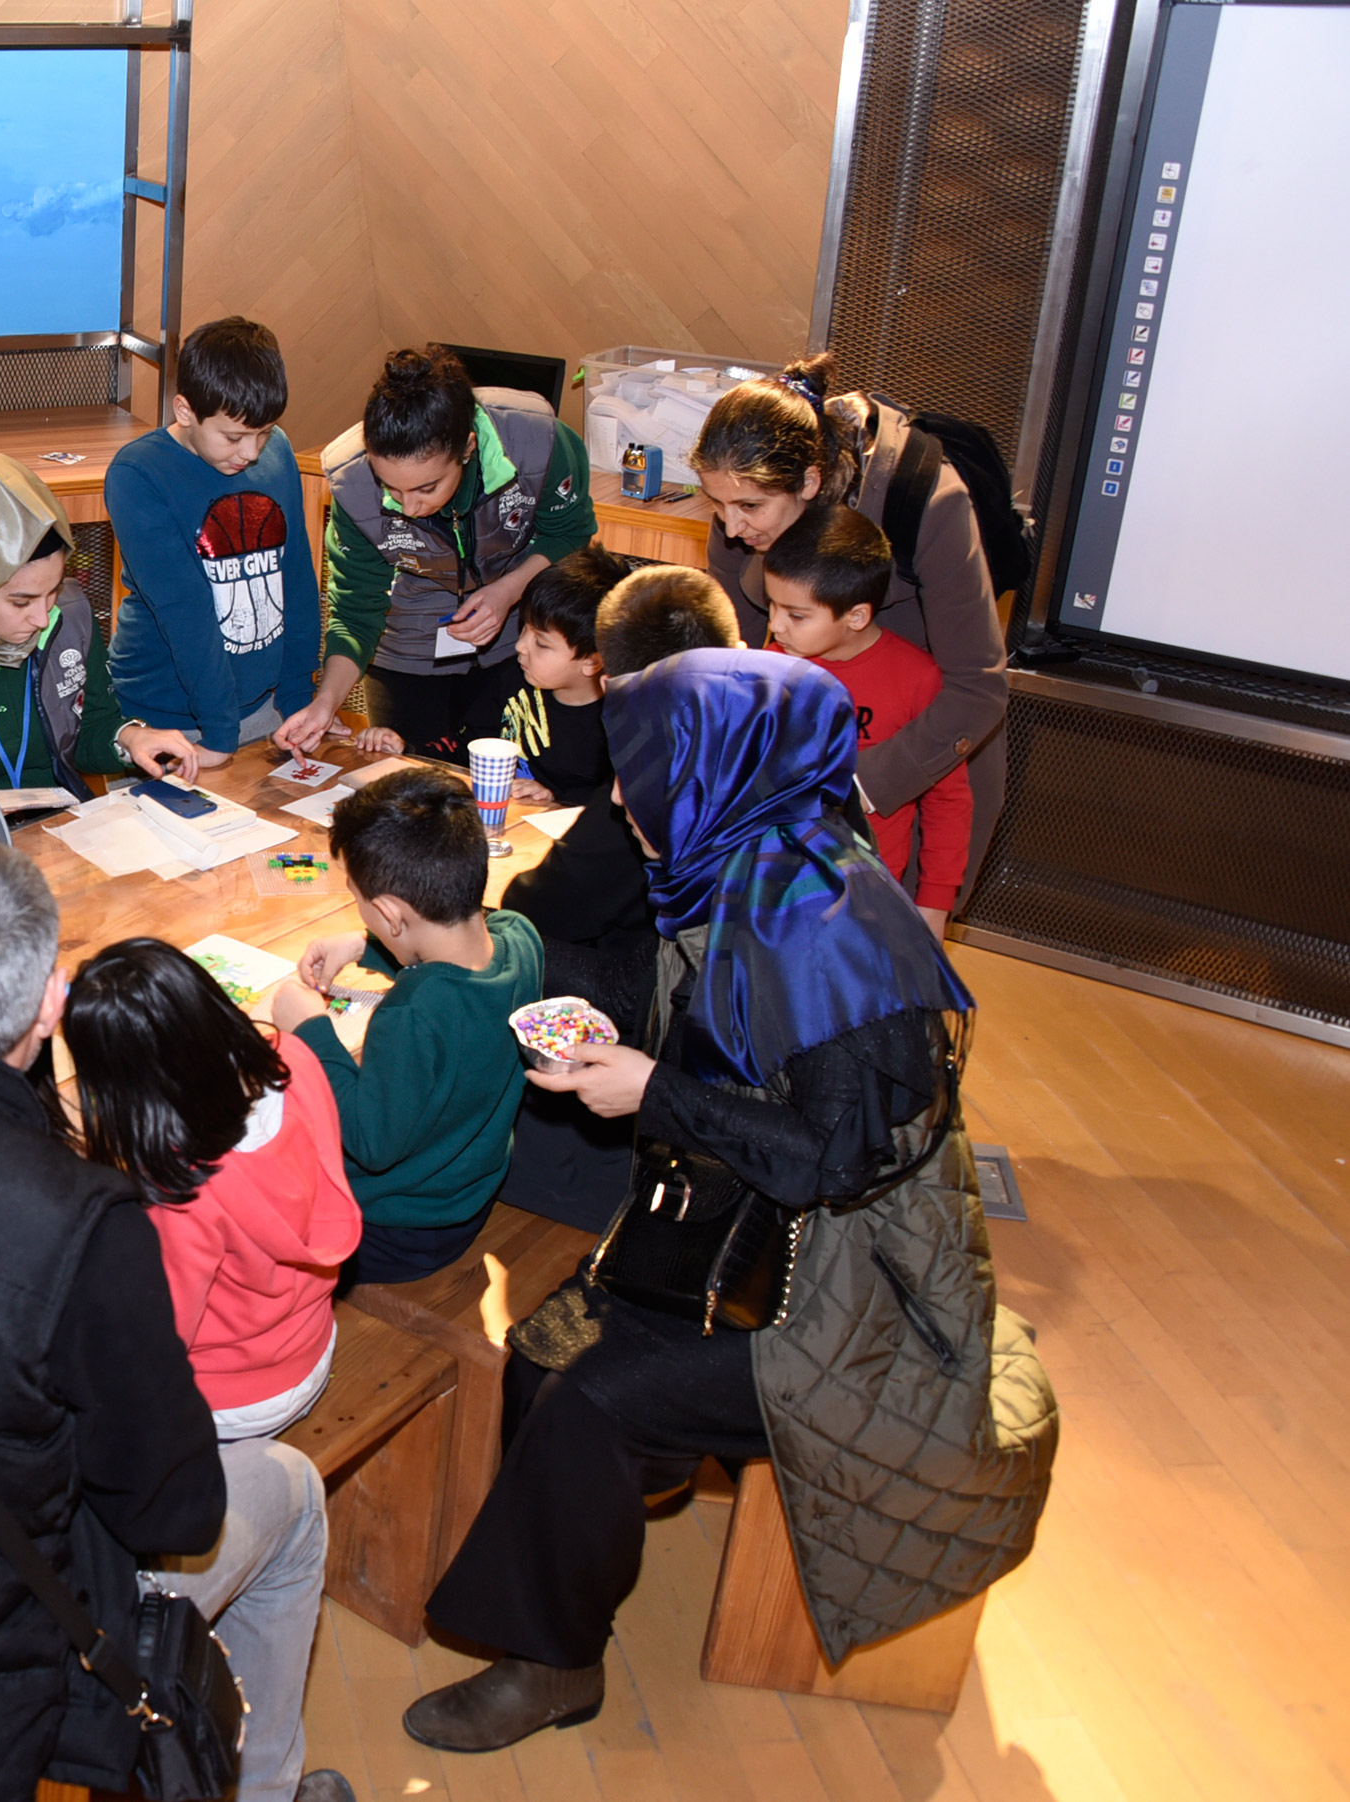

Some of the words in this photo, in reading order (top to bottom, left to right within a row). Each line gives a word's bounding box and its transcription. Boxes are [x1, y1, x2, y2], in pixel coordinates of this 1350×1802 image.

[243, 549, 279, 576] GIVE
[254, 640, 263, 651] IS
[264, 634, 273, 647] TO
